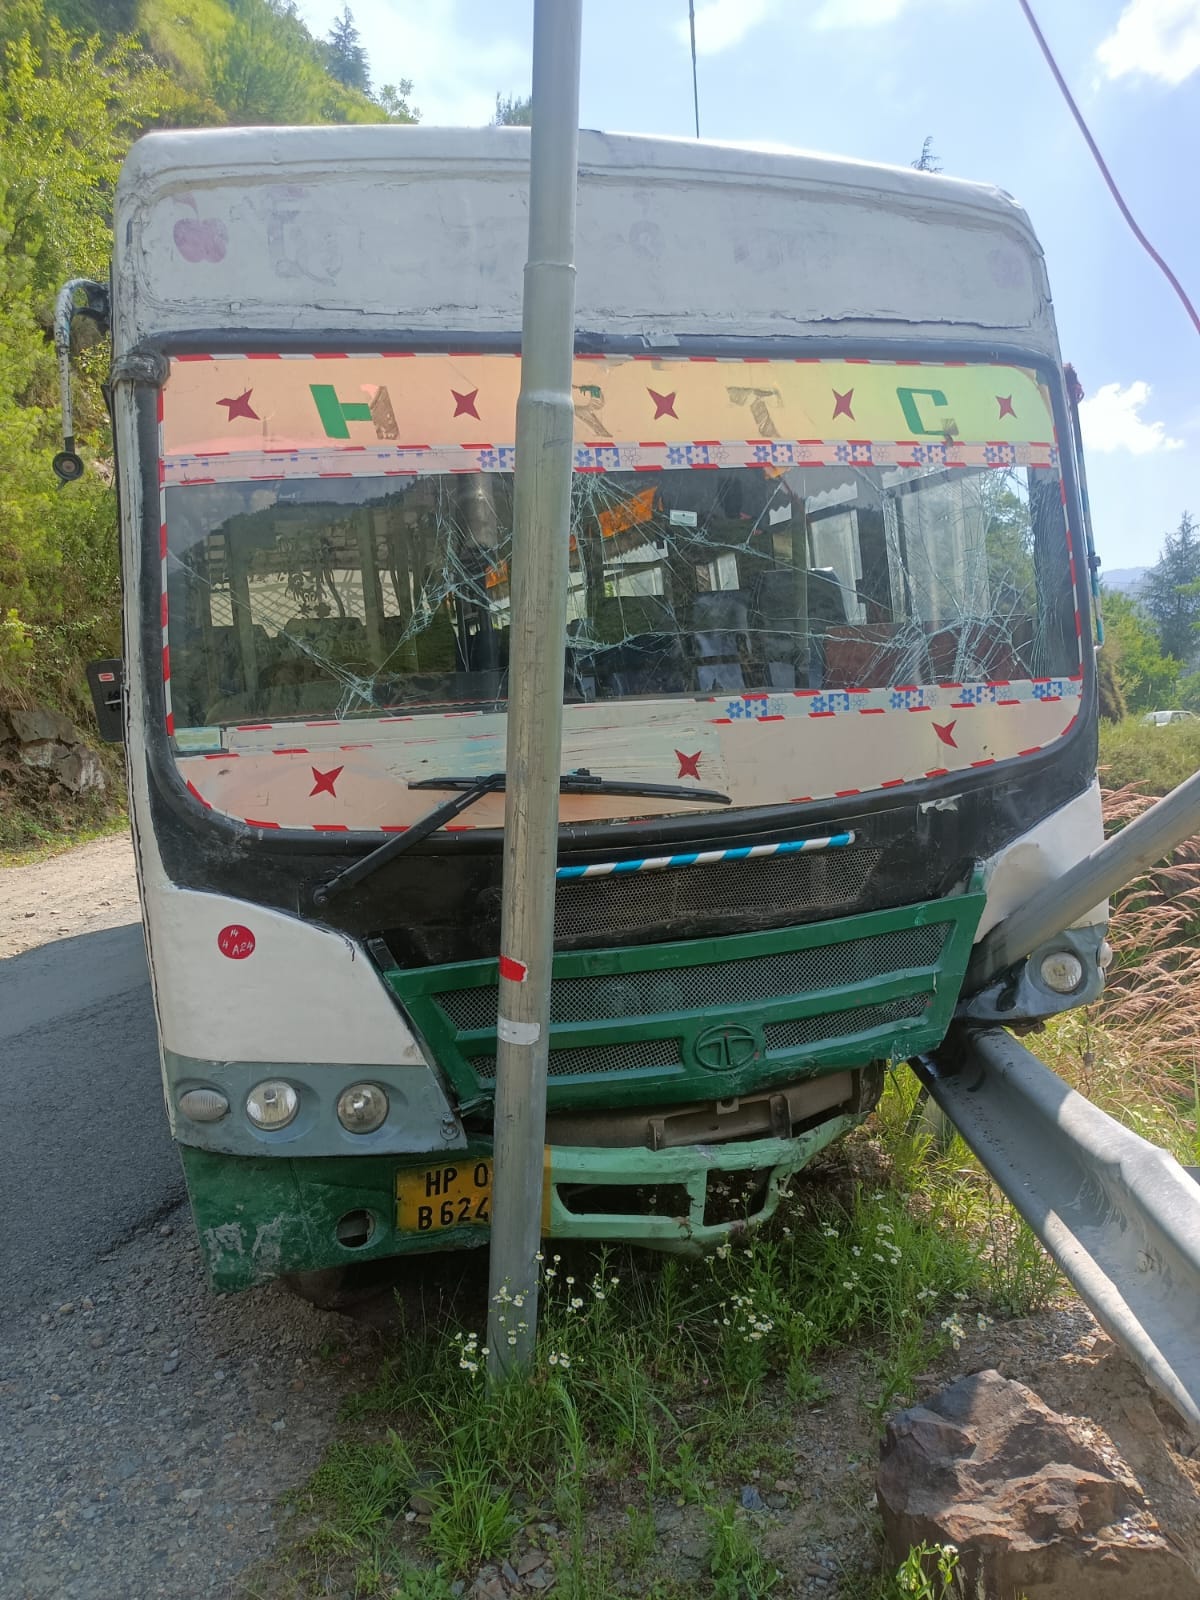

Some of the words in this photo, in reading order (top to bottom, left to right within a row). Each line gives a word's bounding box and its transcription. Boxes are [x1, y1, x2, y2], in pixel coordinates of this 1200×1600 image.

[425, 1167, 457, 1197] HP
[474, 1163, 489, 1187] 0
[418, 1197, 489, 1231] B624
